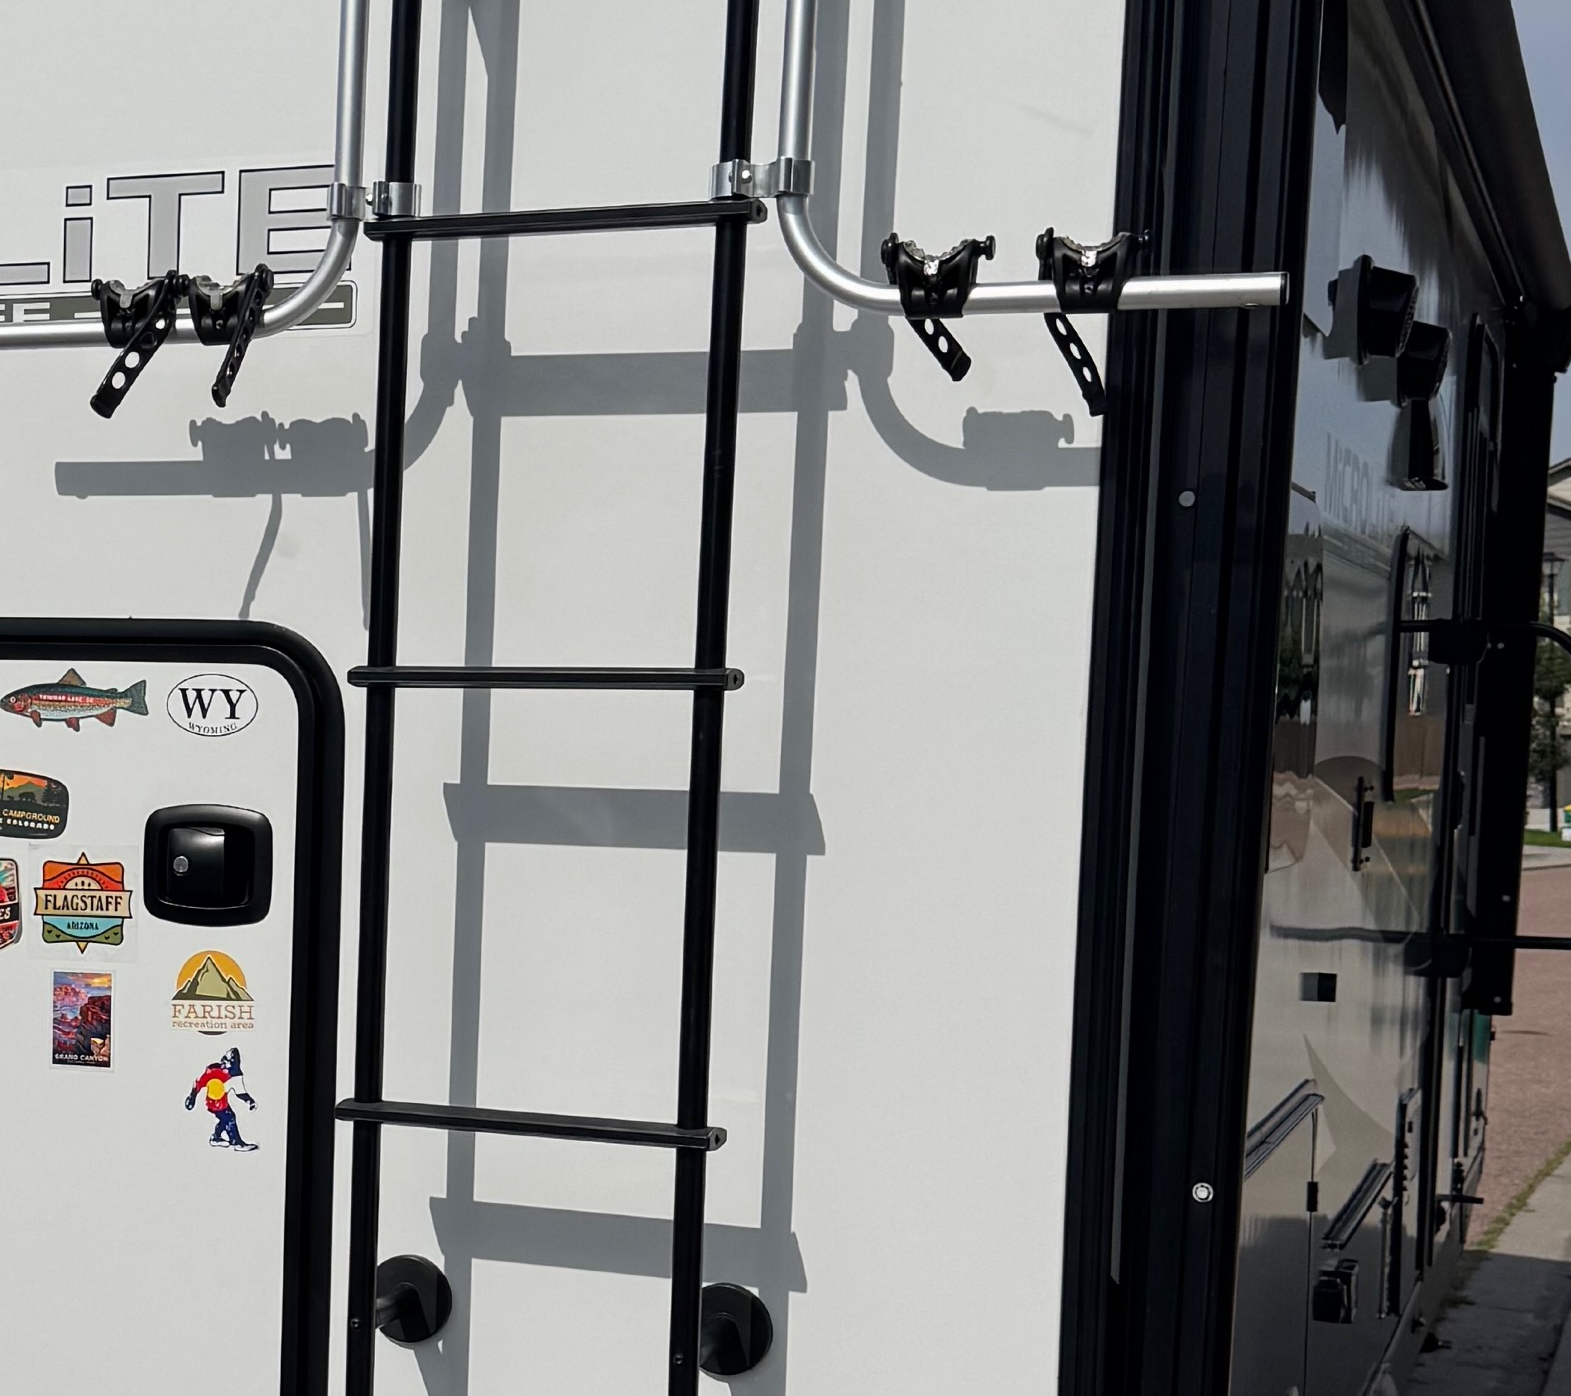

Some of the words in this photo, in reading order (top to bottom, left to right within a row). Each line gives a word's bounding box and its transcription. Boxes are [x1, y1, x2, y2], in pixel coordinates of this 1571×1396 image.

[178, 687, 247, 719] WY
[188, 722, 238, 734] WYOMING
[2, 809, 61, 824] CAMPGROUND
[6, 818, 55, 831] COLORADO
[44, 894, 123, 912] FLAGSTAFF
[67, 921, 99, 930] ARIZONA
[171, 1003, 255, 1020] FARISH
[172, 1019, 228, 1029] recreation
[230, 1021, 254, 1029] area
